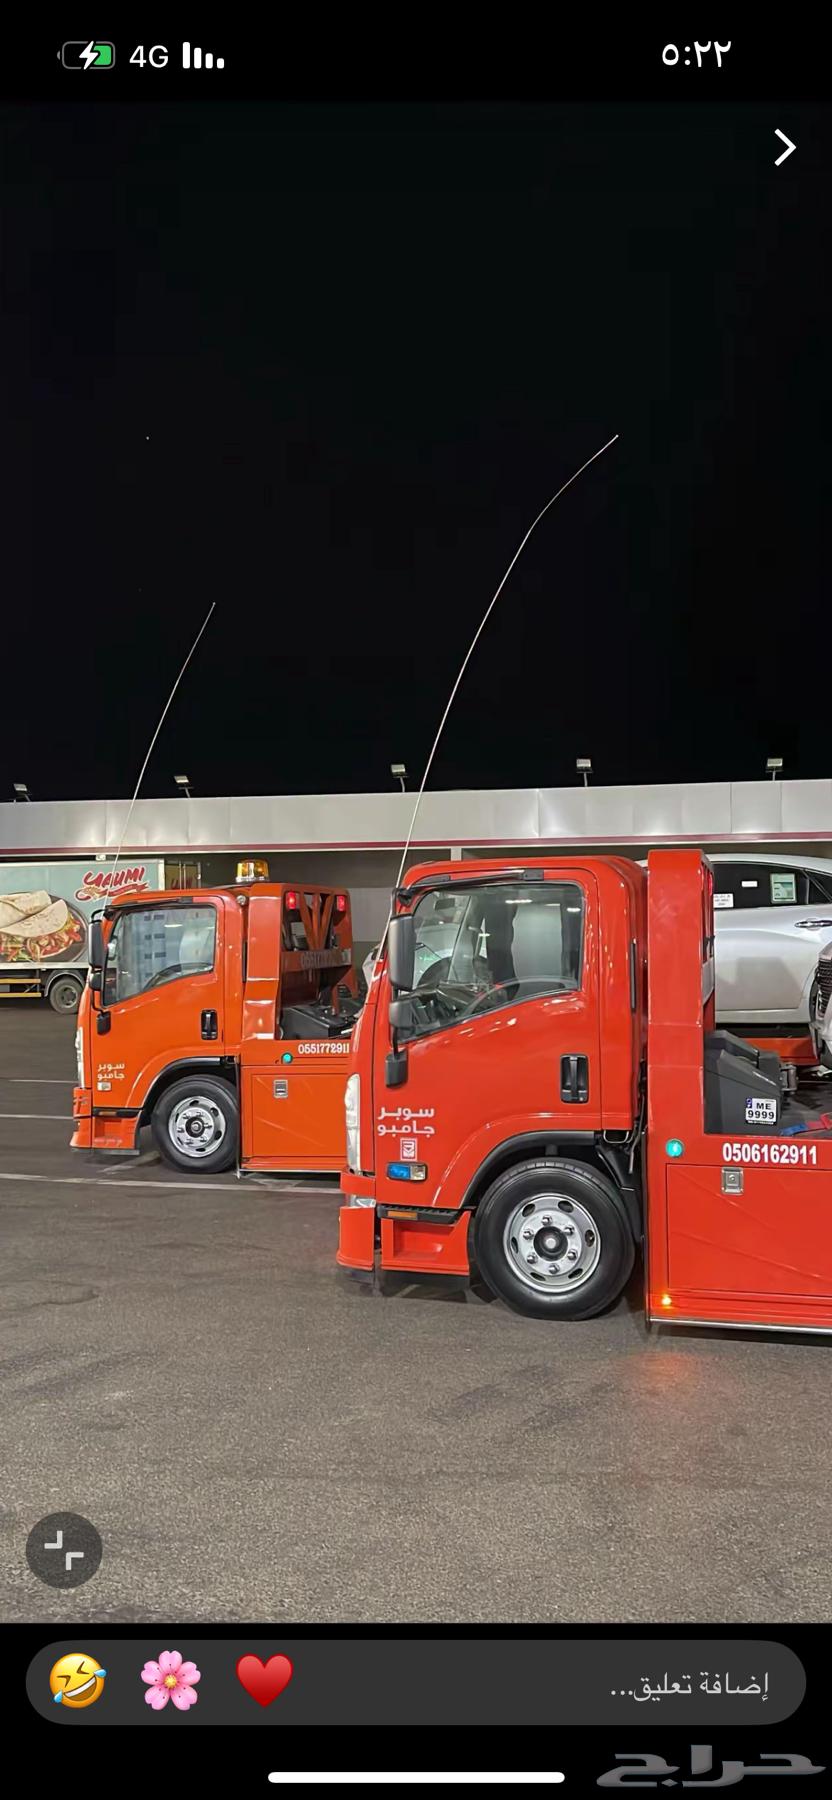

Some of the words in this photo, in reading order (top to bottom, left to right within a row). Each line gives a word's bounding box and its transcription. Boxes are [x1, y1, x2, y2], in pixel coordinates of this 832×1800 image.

[297, 1042, 351, 1055] 0551772911
[377, 1106, 435, 1121] سوبر
[755, 1102, 773, 1111] ME
[746, 1109, 776, 1120] 9999
[376, 1119, 436, 1138] جامبو
[722, 1142, 818, 1166] 0506162911
